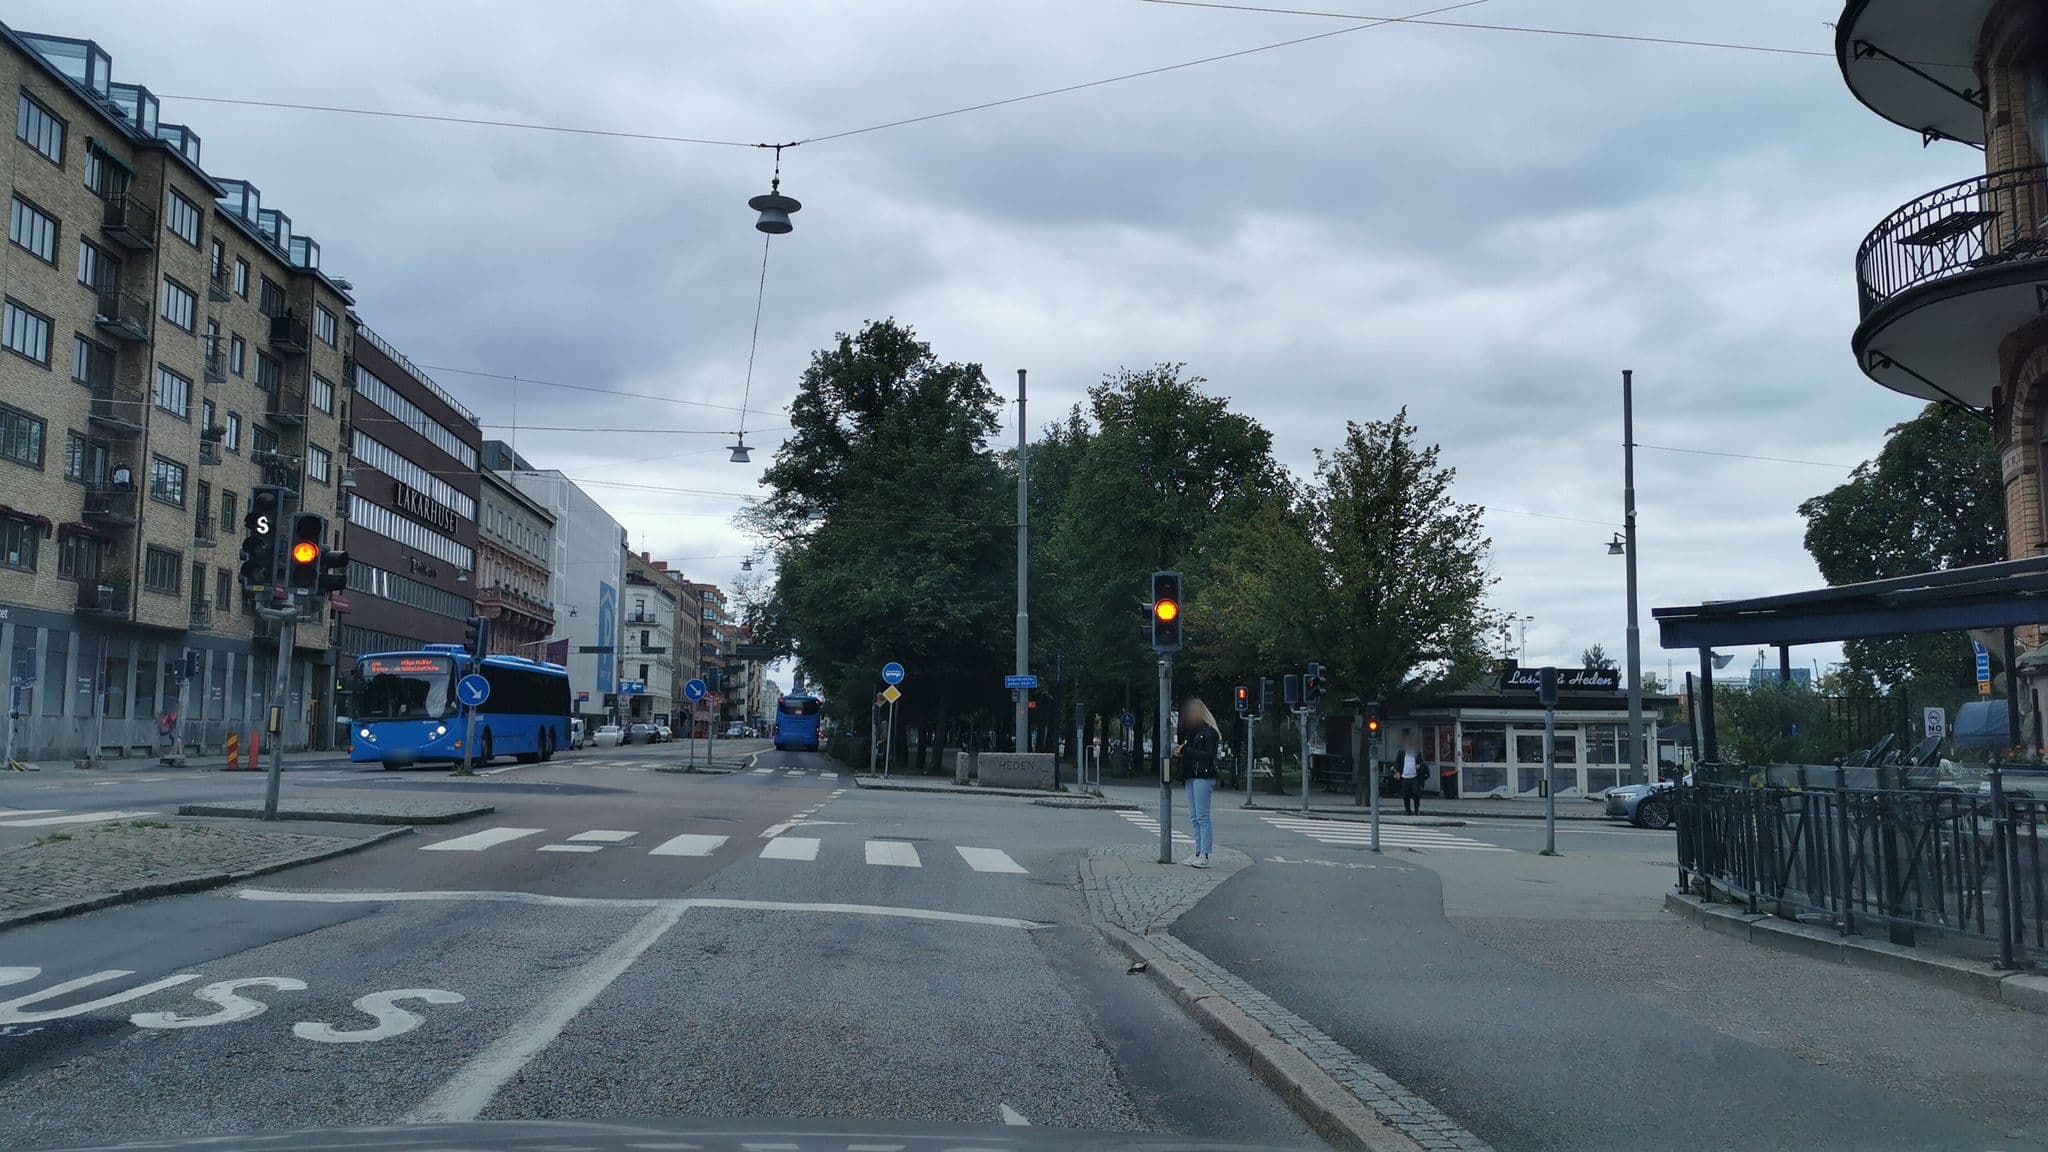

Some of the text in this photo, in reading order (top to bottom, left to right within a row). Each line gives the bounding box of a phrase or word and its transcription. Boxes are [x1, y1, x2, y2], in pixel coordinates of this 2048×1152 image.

[1569, 671, 1613, 686] Heden
[1928, 724, 1942, 732] NO
[999, 760, 1035, 770] HEDEN
